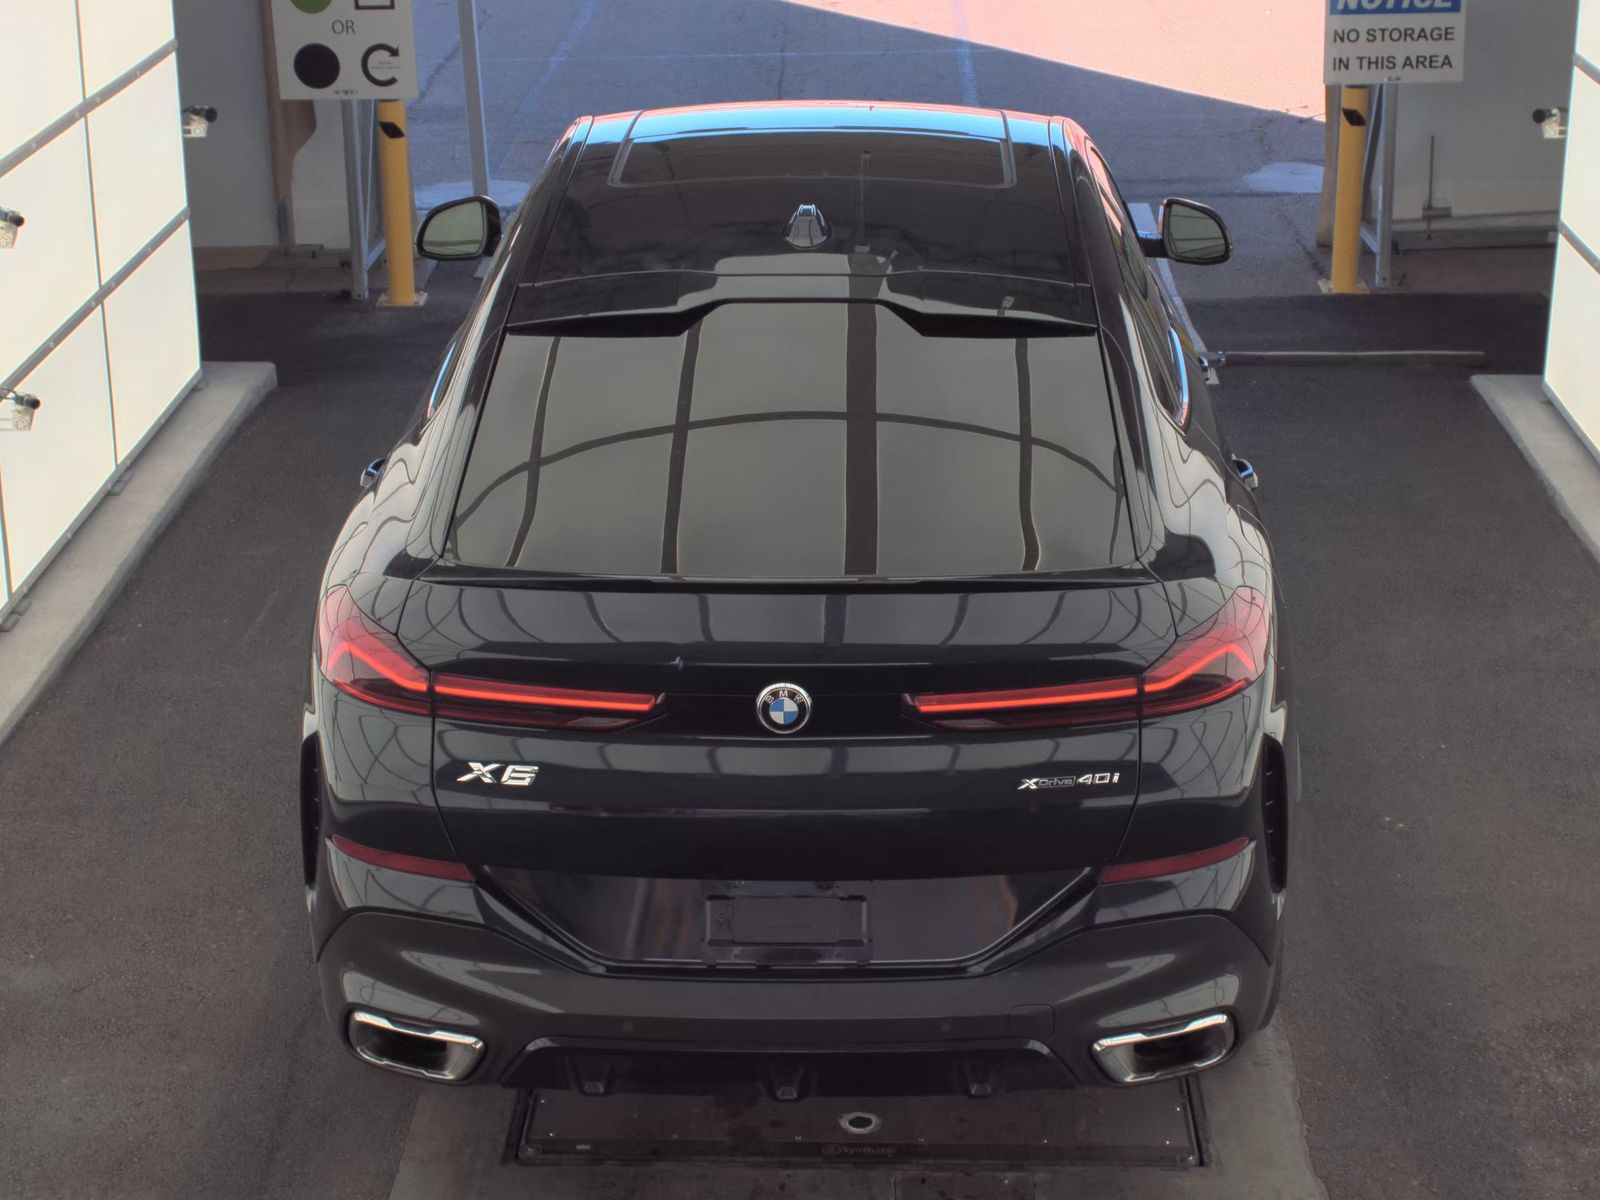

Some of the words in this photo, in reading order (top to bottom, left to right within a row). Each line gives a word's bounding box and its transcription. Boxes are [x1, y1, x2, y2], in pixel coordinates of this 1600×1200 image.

[331, 19, 356, 35] OR
[1333, 29, 1360, 43] NO
[1366, 27, 1456, 43] STORAGE
[1333, 57, 1350, 71] IN
[1356, 56, 1397, 70] THIS
[1402, 55, 1453, 69] AREA
[764, 690, 804, 704] BMW
[456, 762, 539, 786] X6
